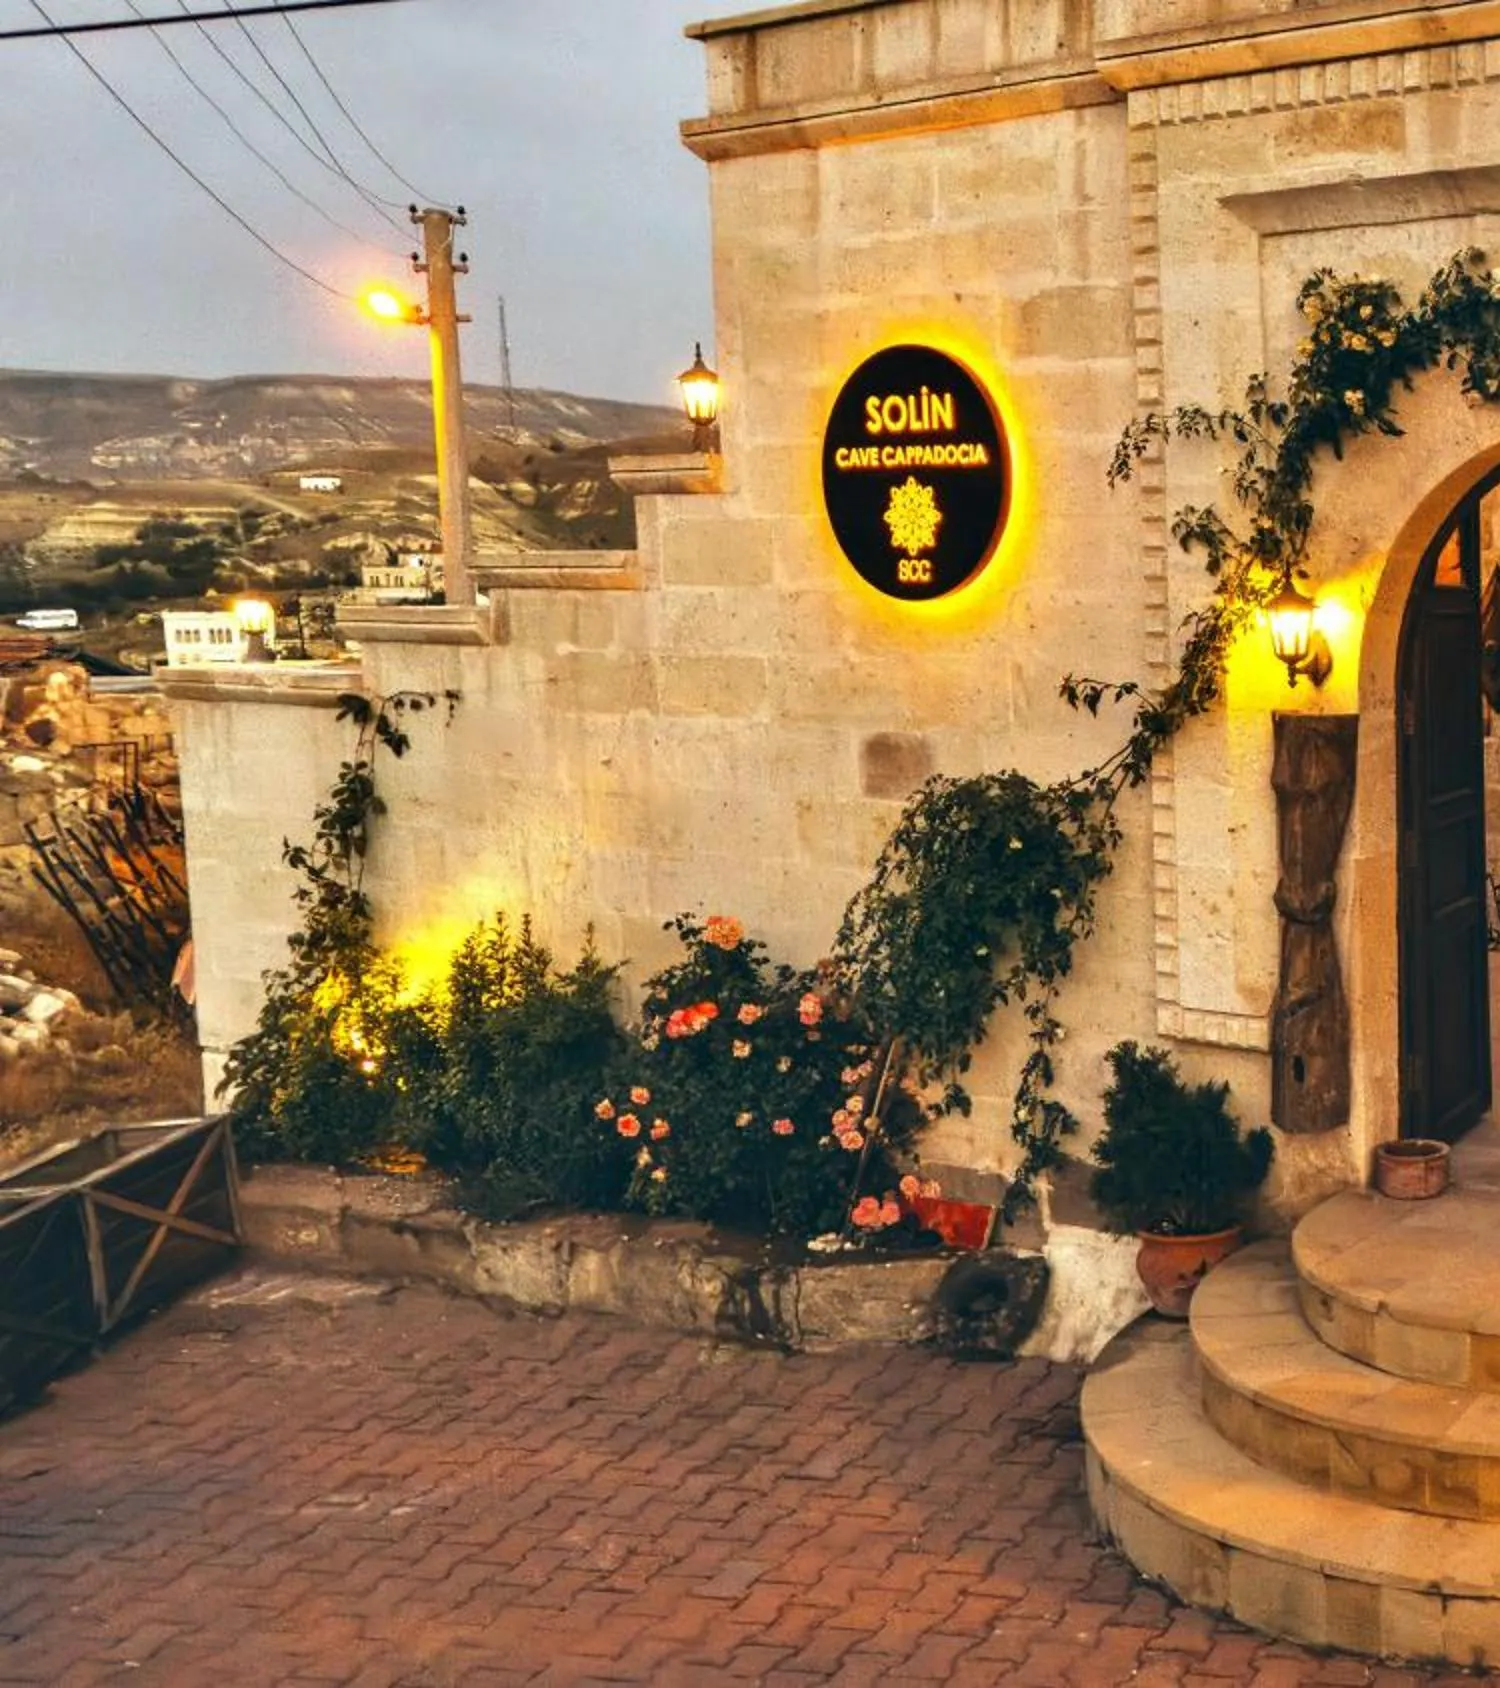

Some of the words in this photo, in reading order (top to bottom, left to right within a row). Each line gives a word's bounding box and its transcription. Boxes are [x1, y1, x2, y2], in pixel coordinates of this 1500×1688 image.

[835, 447, 879, 468] CAVE
[882, 444, 988, 466] CAPPADOCIA
[898, 560, 931, 582] SCC
